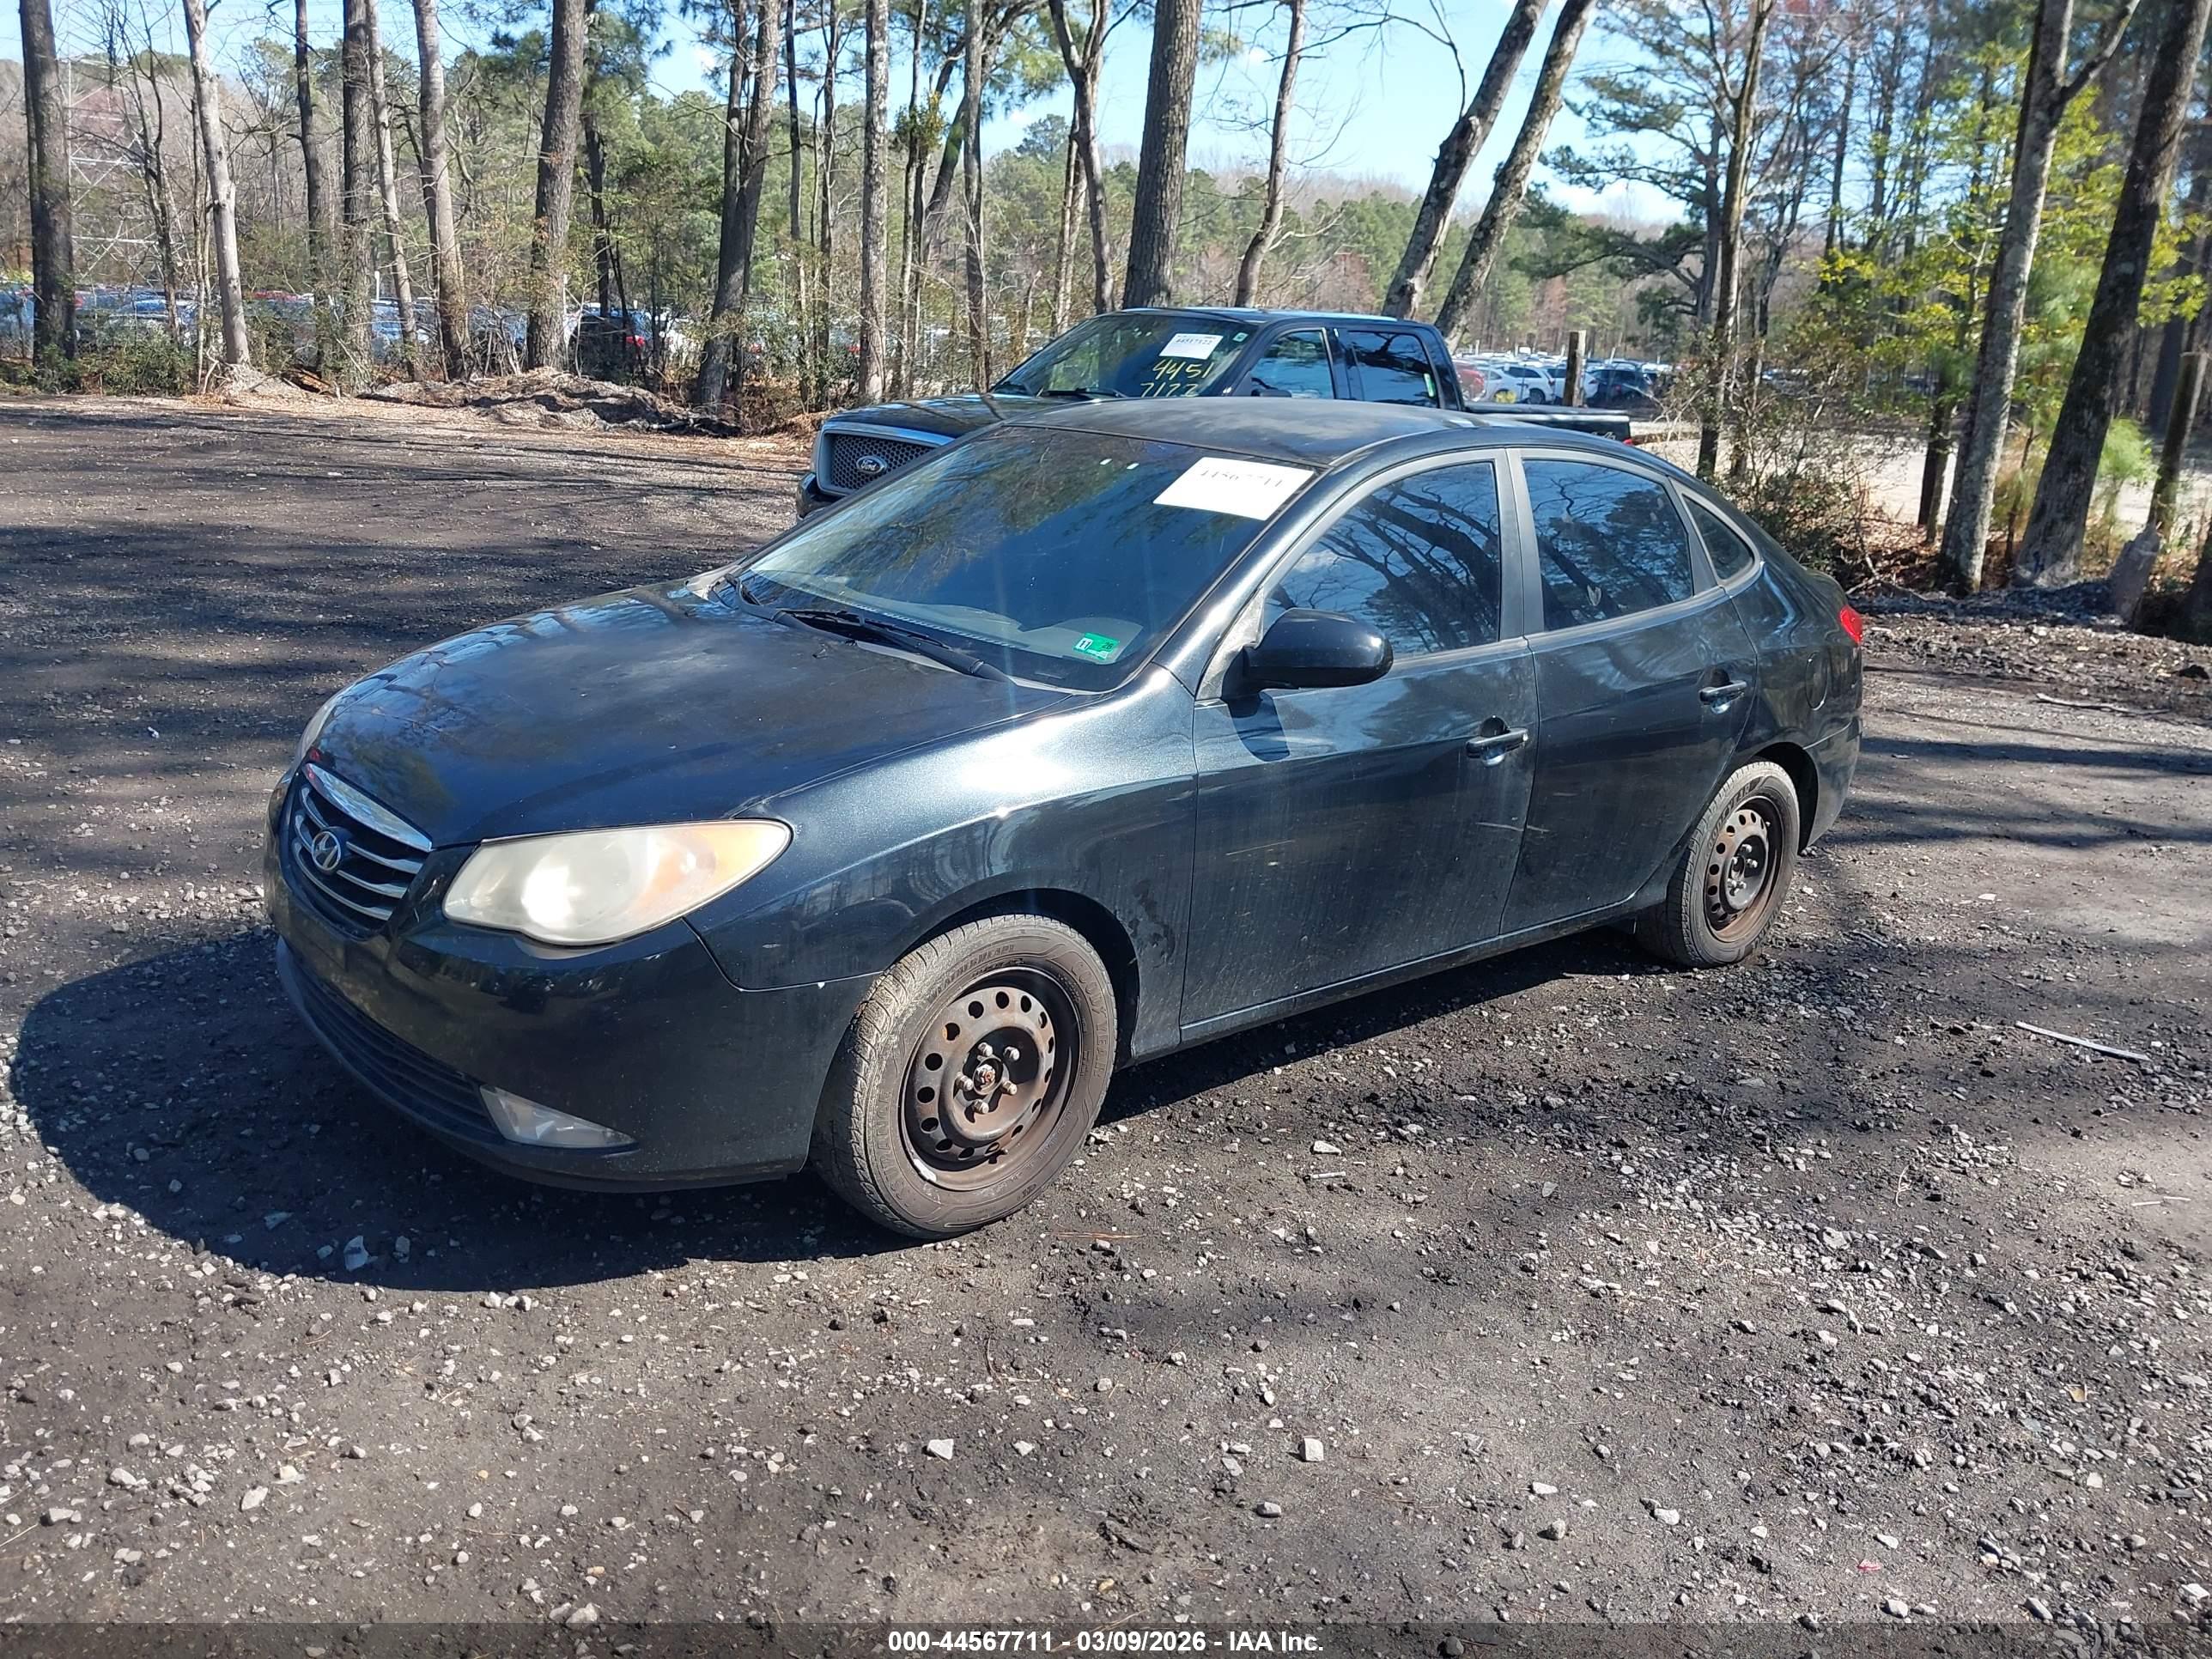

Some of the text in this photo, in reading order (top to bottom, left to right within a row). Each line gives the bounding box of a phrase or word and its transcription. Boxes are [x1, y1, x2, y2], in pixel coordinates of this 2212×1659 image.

[1152, 359, 1214, 380] 4451
[860, 459, 877, 471] Ford
[1079, 639, 1115, 651] 11 26
